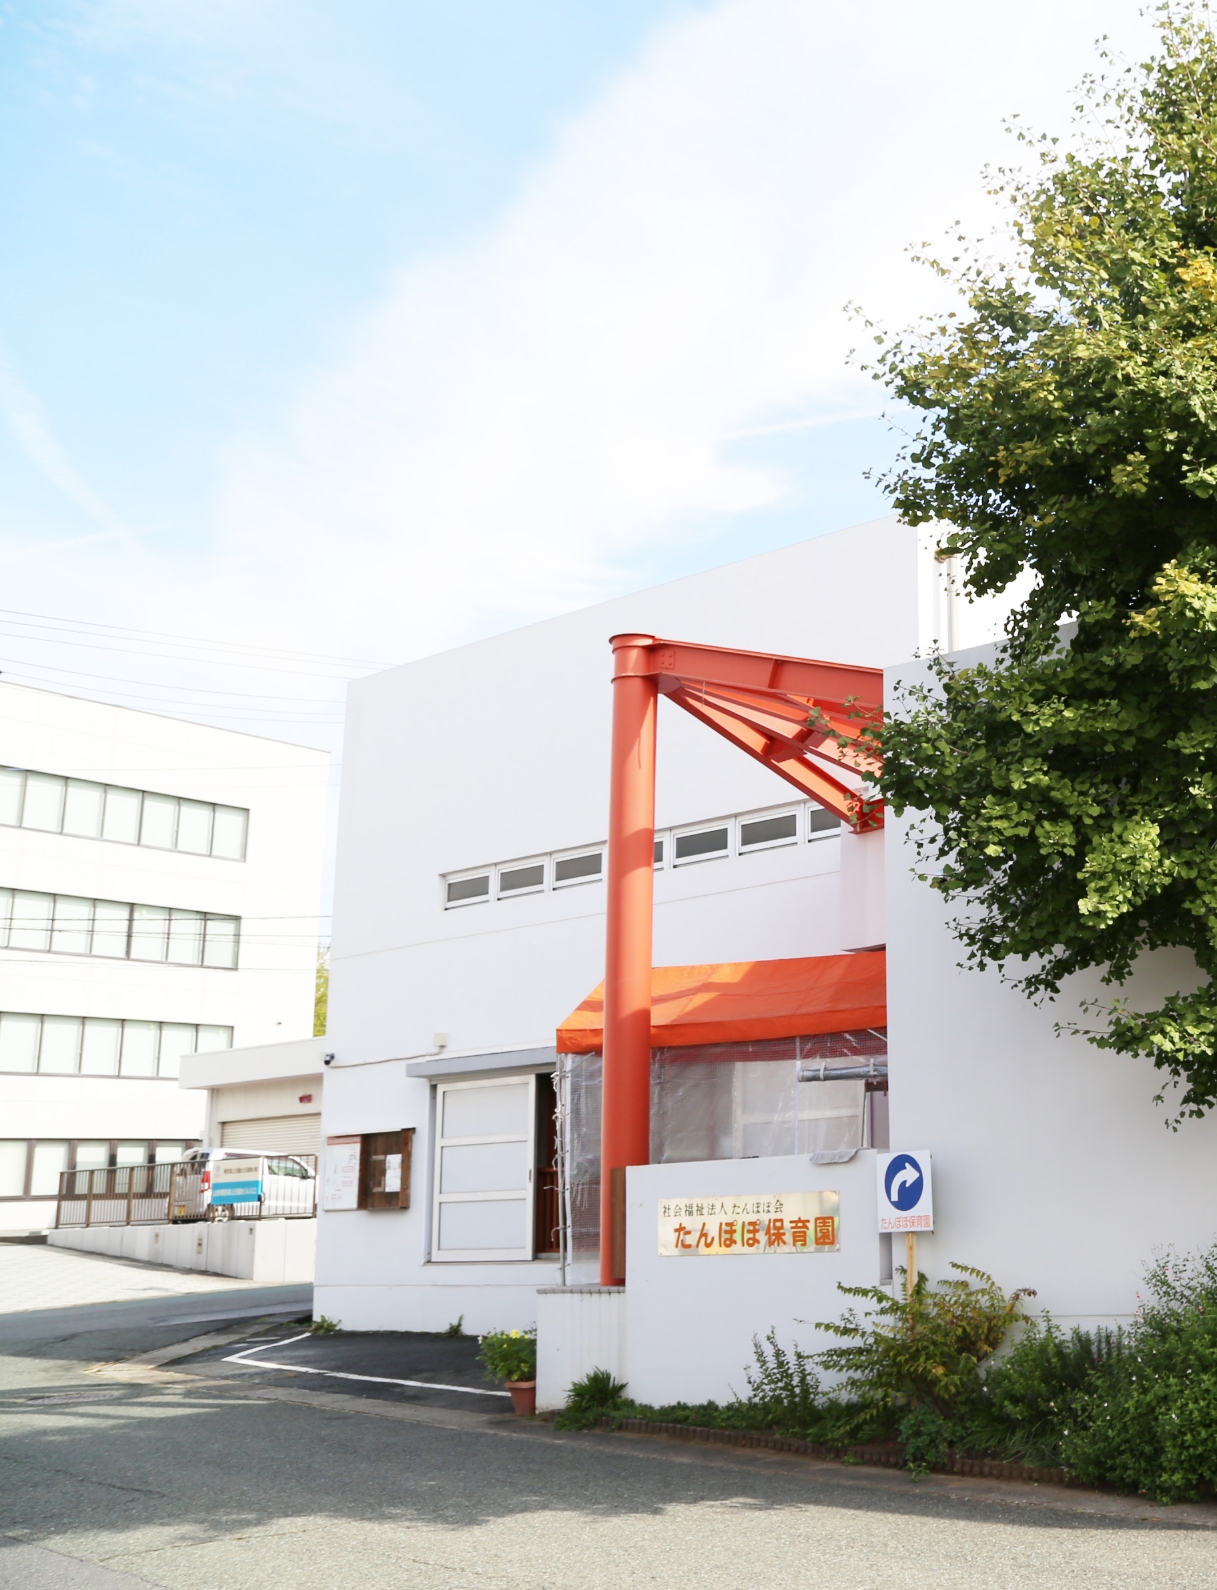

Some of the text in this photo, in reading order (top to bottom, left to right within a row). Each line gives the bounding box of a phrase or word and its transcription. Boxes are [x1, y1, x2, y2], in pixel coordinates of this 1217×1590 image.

[674, 1216, 836, 1249] たんぽぽ保育園
[880, 1214, 931, 1230] たんぽぽ保育園
